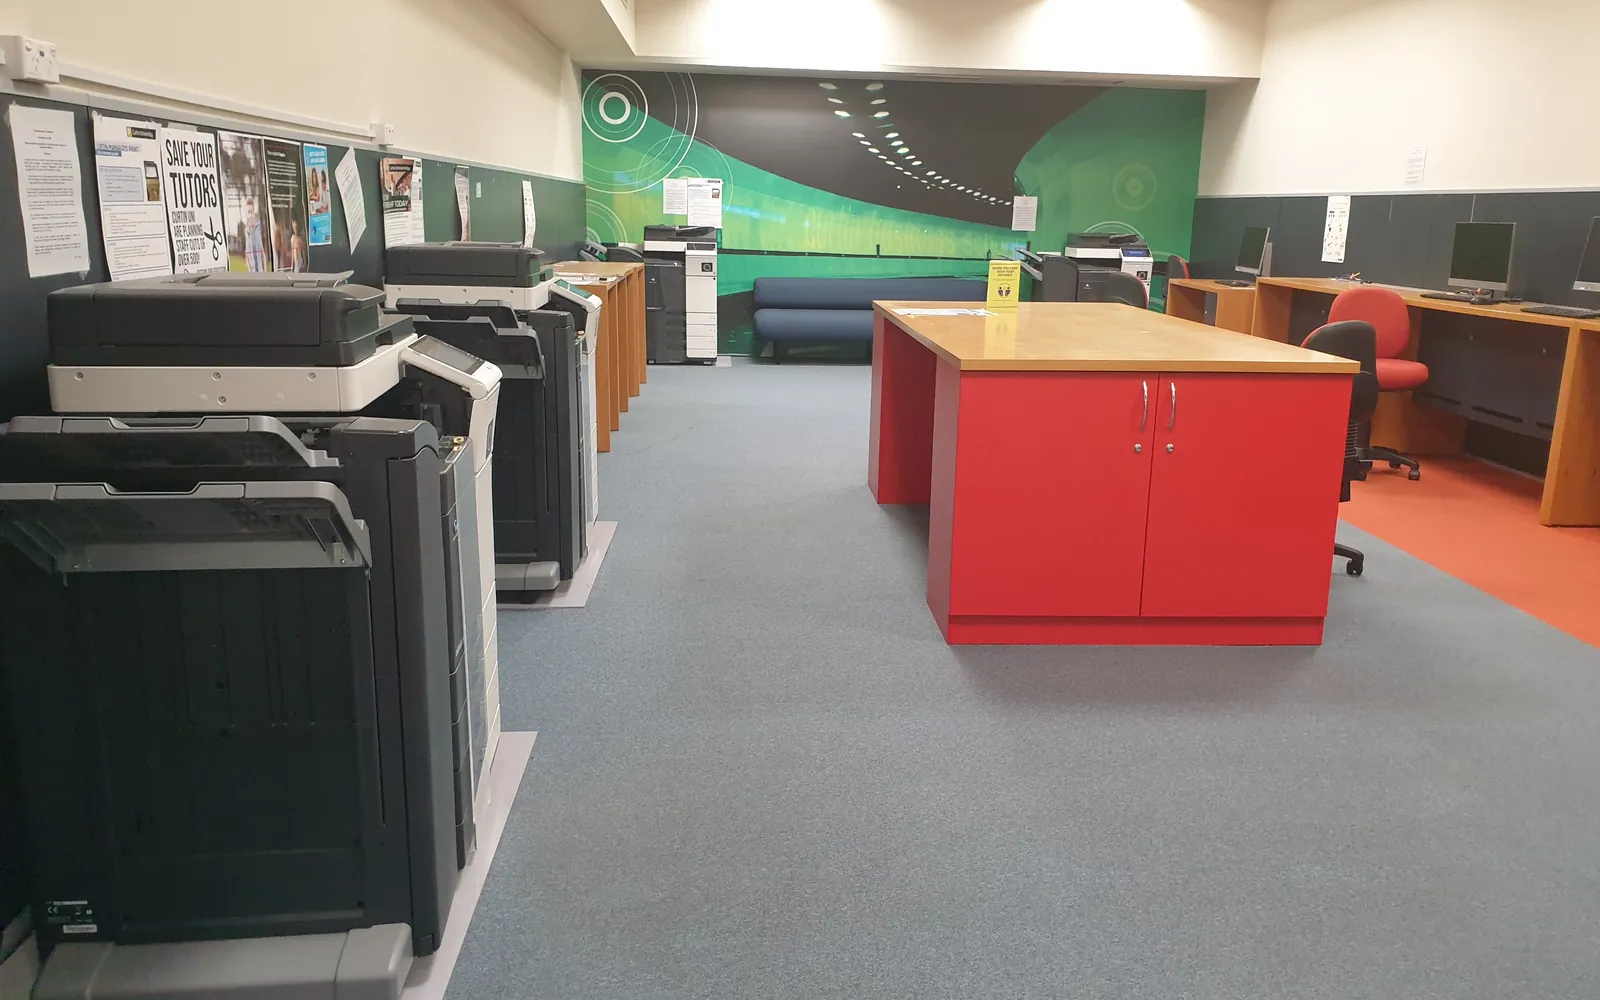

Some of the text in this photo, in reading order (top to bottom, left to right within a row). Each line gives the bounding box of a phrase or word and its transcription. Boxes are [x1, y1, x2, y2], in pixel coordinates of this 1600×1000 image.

[165, 139, 214, 168] SAVE YOUR
[170, 172, 217, 208] TUTORS
[394, 200, 408, 208] TODAY
[174, 224, 203, 237] ARE PLANNING
[176, 238, 206, 252] STAFF CUTS OF
[178, 253, 189, 266] OVER
